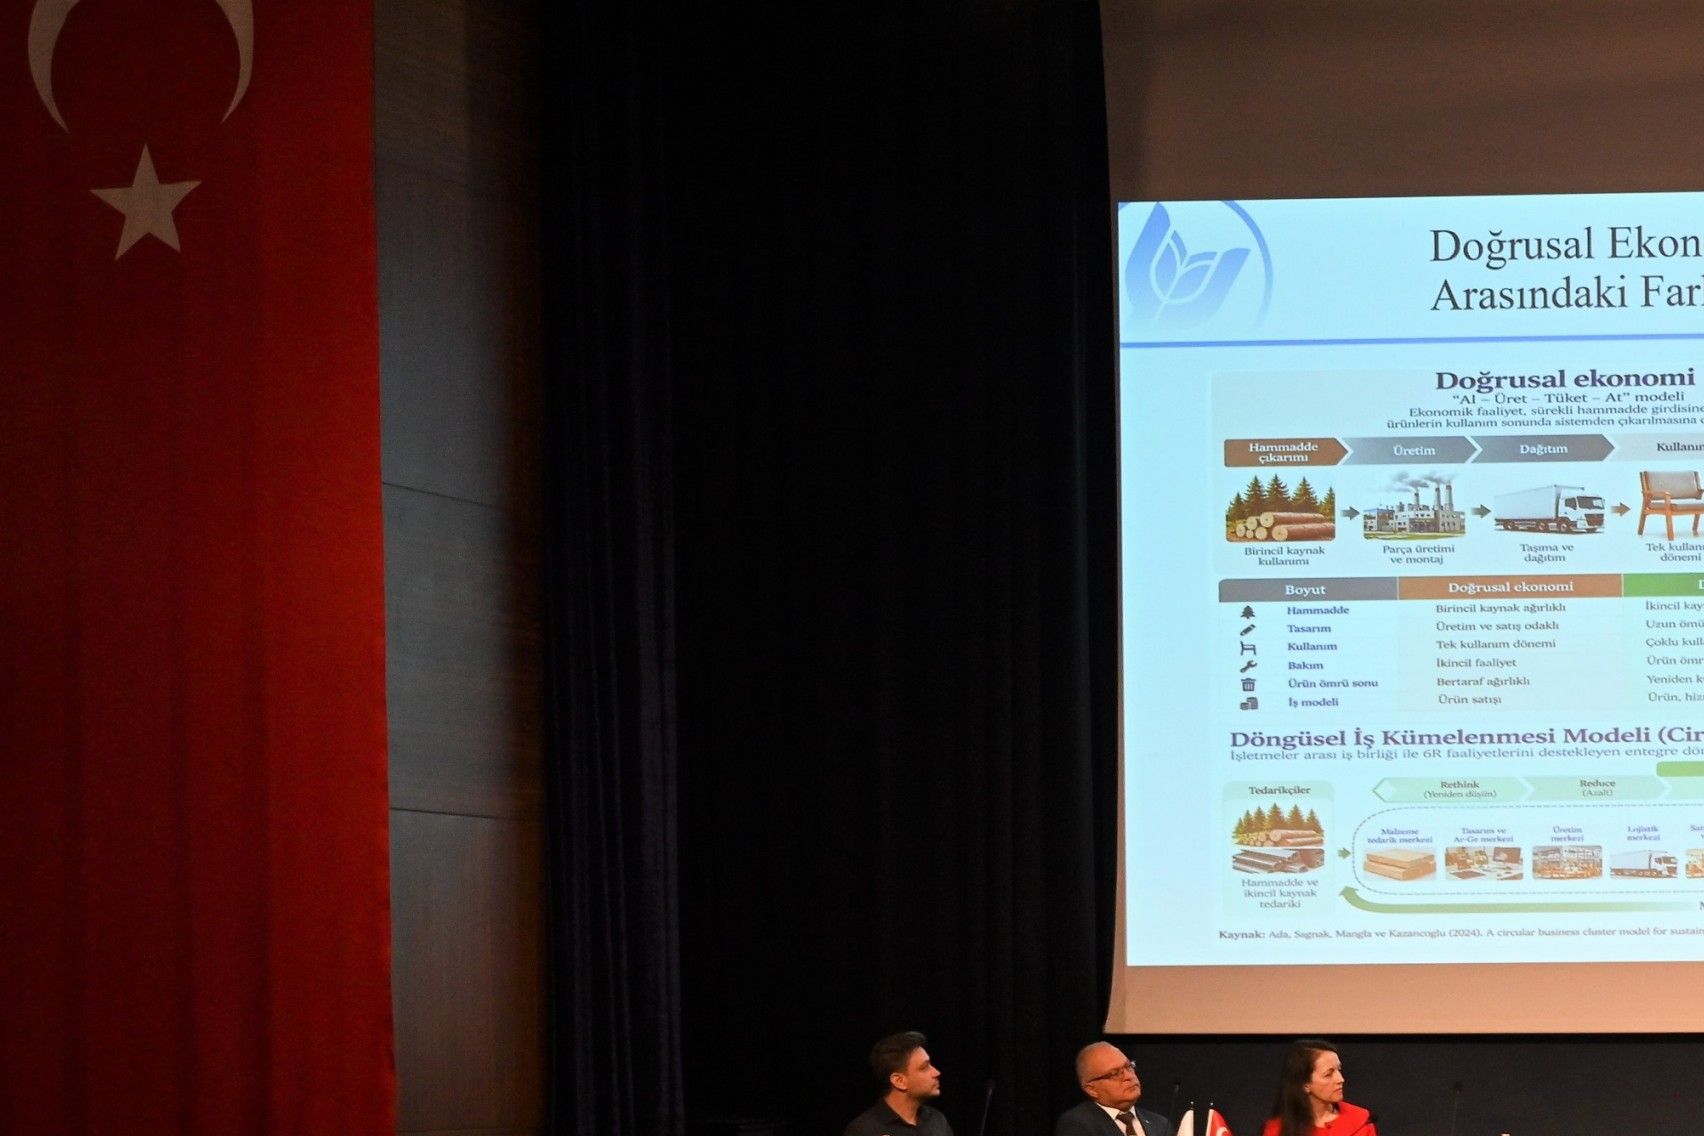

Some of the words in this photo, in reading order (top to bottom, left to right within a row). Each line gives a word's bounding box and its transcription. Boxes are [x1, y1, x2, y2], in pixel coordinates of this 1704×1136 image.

[1430, 225, 1594, 271] Doğrusal
[1430, 274, 1628, 311] Arasındaki
[1435, 369, 1566, 395] Doğrusal
[1573, 367, 1696, 388] ekonomi
[1494, 392, 1528, 404] Üret
[1543, 392, 1587, 403] Tüket
[1634, 391, 1685, 402] modeli
[1409, 406, 1473, 417] Ekonomik
[1477, 406, 1526, 418] faaliyet,
[1530, 405, 1573, 415] sürekli
[1577, 404, 1648, 414] hammadde
[1387, 418, 1442, 428] ürünlerin
[1446, 418, 1497, 427] kullanım
[1501, 415, 1551, 427] sonunda
[1555, 416, 1614, 426] sistemden
[1617, 413, 1696, 427] çıkarılmasına
[1249, 441, 1318, 452] Hammadde
[1393, 444, 1435, 456] Üretim
[1519, 443, 1568, 456] Dağıtım
[1258, 452, 1308, 464] çıkarımı
[1244, 546, 1283, 559] Birincil
[1286, 545, 1325, 557] kaynak
[1383, 545, 1412, 555] Parça
[1415, 544, 1455, 556] üretimi
[1519, 543, 1559, 554] Taşıma
[1645, 542, 1665, 551] Tek
[1258, 556, 1309, 566] kullanımı
[1405, 555, 1444, 566] montaj
[1524, 552, 1566, 564] dağıtım
[1660, 552, 1701, 561] dönemi
[1285, 584, 1325, 597] Boyut
[1448, 581, 1510, 595] Doğrusal
[1513, 580, 1573, 592] ekonomi
[1287, 605, 1349, 615] Hammadde
[1436, 604, 1476, 613] Birincil
[1480, 603, 1520, 614] kaynak
[1523, 602, 1566, 613] ağırlıklı
[1287, 623, 1331, 633] Tasarım
[1436, 620, 1476, 631] Üretim
[1496, 623, 1521, 632] satış
[1524, 620, 1559, 630] odaklı
[1287, 641, 1337, 651] Kullanım
[1435, 640, 1457, 649] Tek
[1460, 639, 1509, 649] kullanım
[1512, 639, 1556, 648] dönemi
[1288, 661, 1324, 670] Bakım
[1436, 657, 1471, 668] İkincil
[1475, 657, 1517, 669] faaliyet
[1288, 678, 1316, 688] Ürün
[1319, 679, 1349, 688] ömrü
[1436, 677, 1485, 686] Bertaraf
[1486, 676, 1530, 687] ağırlıklı
[1288, 696, 1298, 708] İş
[1301, 697, 1339, 707] modeli
[1438, 693, 1469, 704] Ürün
[1472, 696, 1501, 705] satışı
[1230, 730, 1346, 751] Döngüsel
[1354, 728, 1375, 750] İş
[1382, 728, 1555, 746] Kümelenmesi
[1563, 726, 1651, 743] Modeli
[1440, 780, 1480, 789] Rethink
[1579, 779, 1616, 787] Reduce
[1248, 785, 1311, 796] Tedarikçiler
[1241, 878, 1304, 887] Hammadde
[1306, 879, 1319, 887] ve
[1244, 889, 1276, 898] ikincil
[1279, 888, 1317, 899] kaynak
[1259, 899, 1301, 908] tedariki
